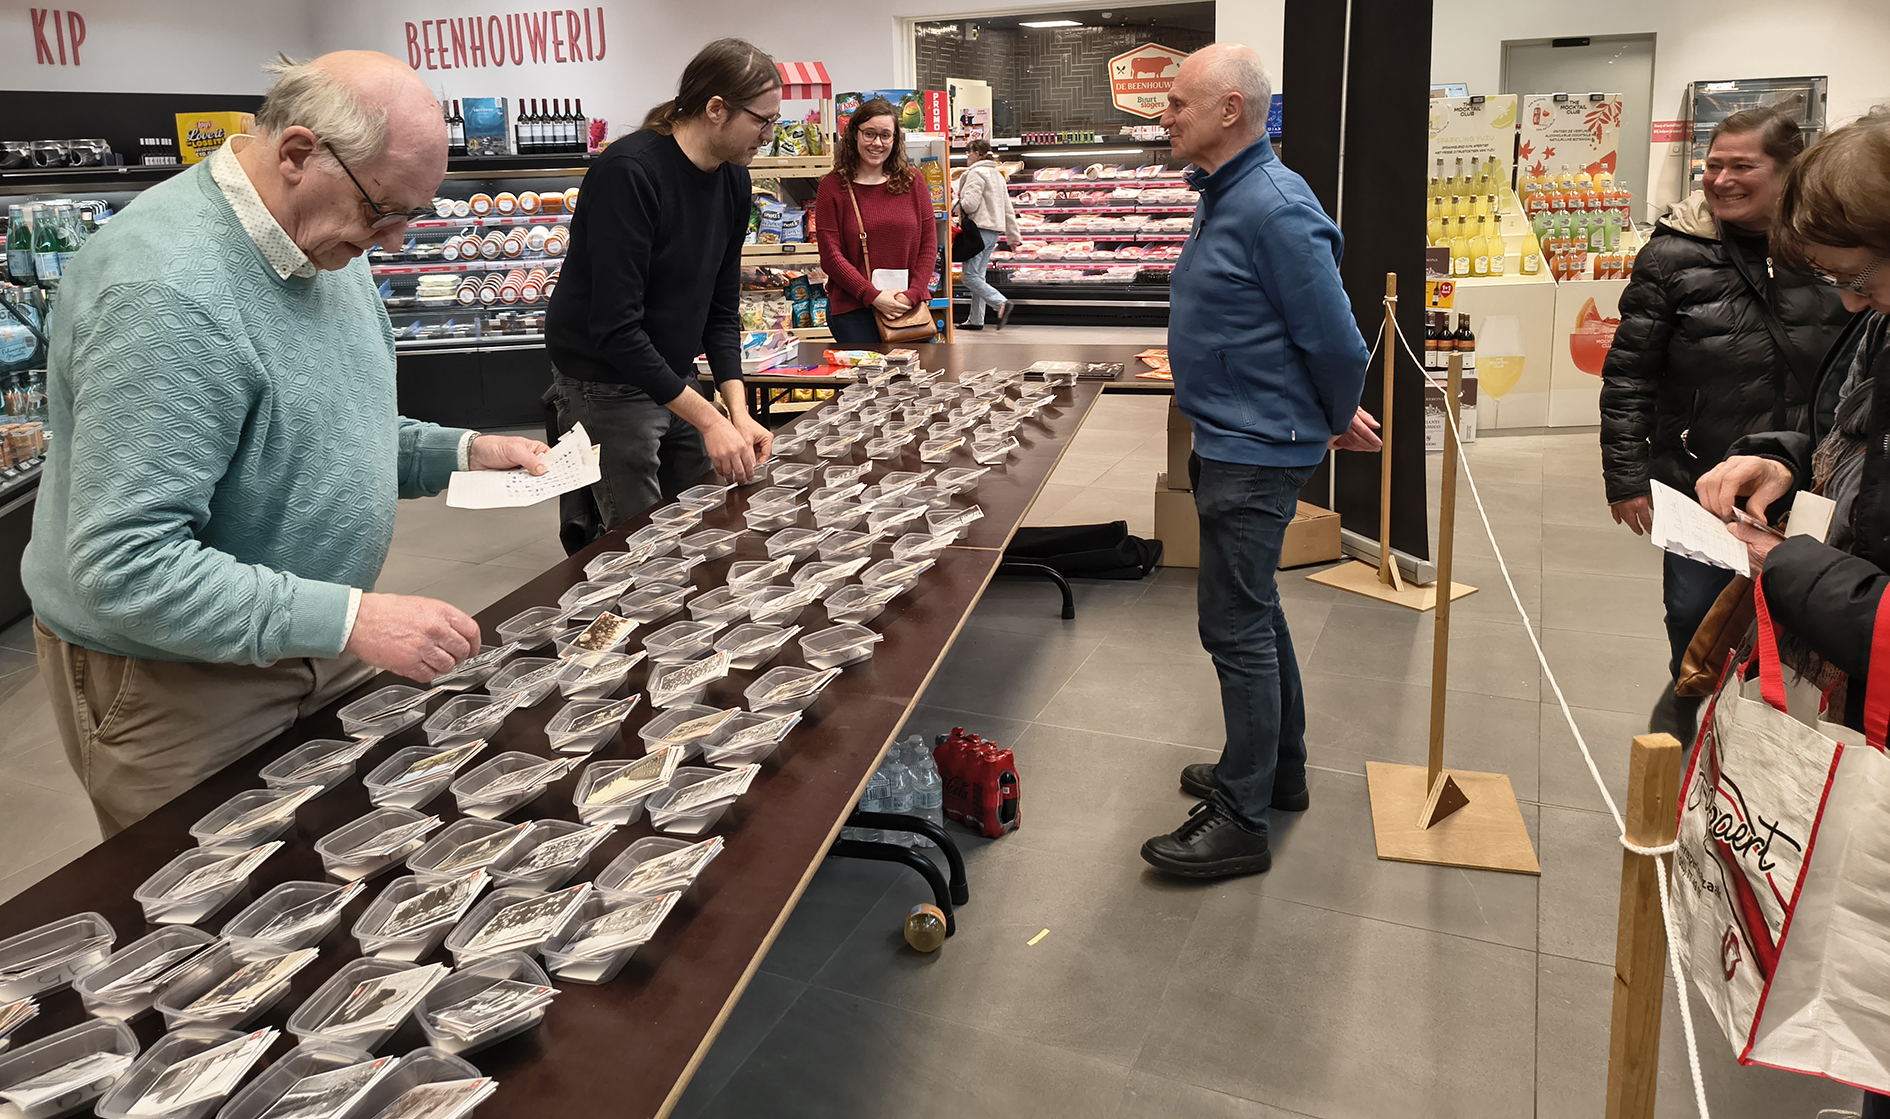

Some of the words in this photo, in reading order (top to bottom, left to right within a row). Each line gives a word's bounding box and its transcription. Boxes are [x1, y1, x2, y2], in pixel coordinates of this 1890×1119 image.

[30, 8, 86, 66] KIP
[405, 7, 606, 70] BEENHOUWERIJ
[932, 92, 941, 131] PROMO
[1141, 101, 1165, 109] slagers
[192, 140, 213, 148] LOSE
[1436, 136, 1475, 144] SPARKLING
